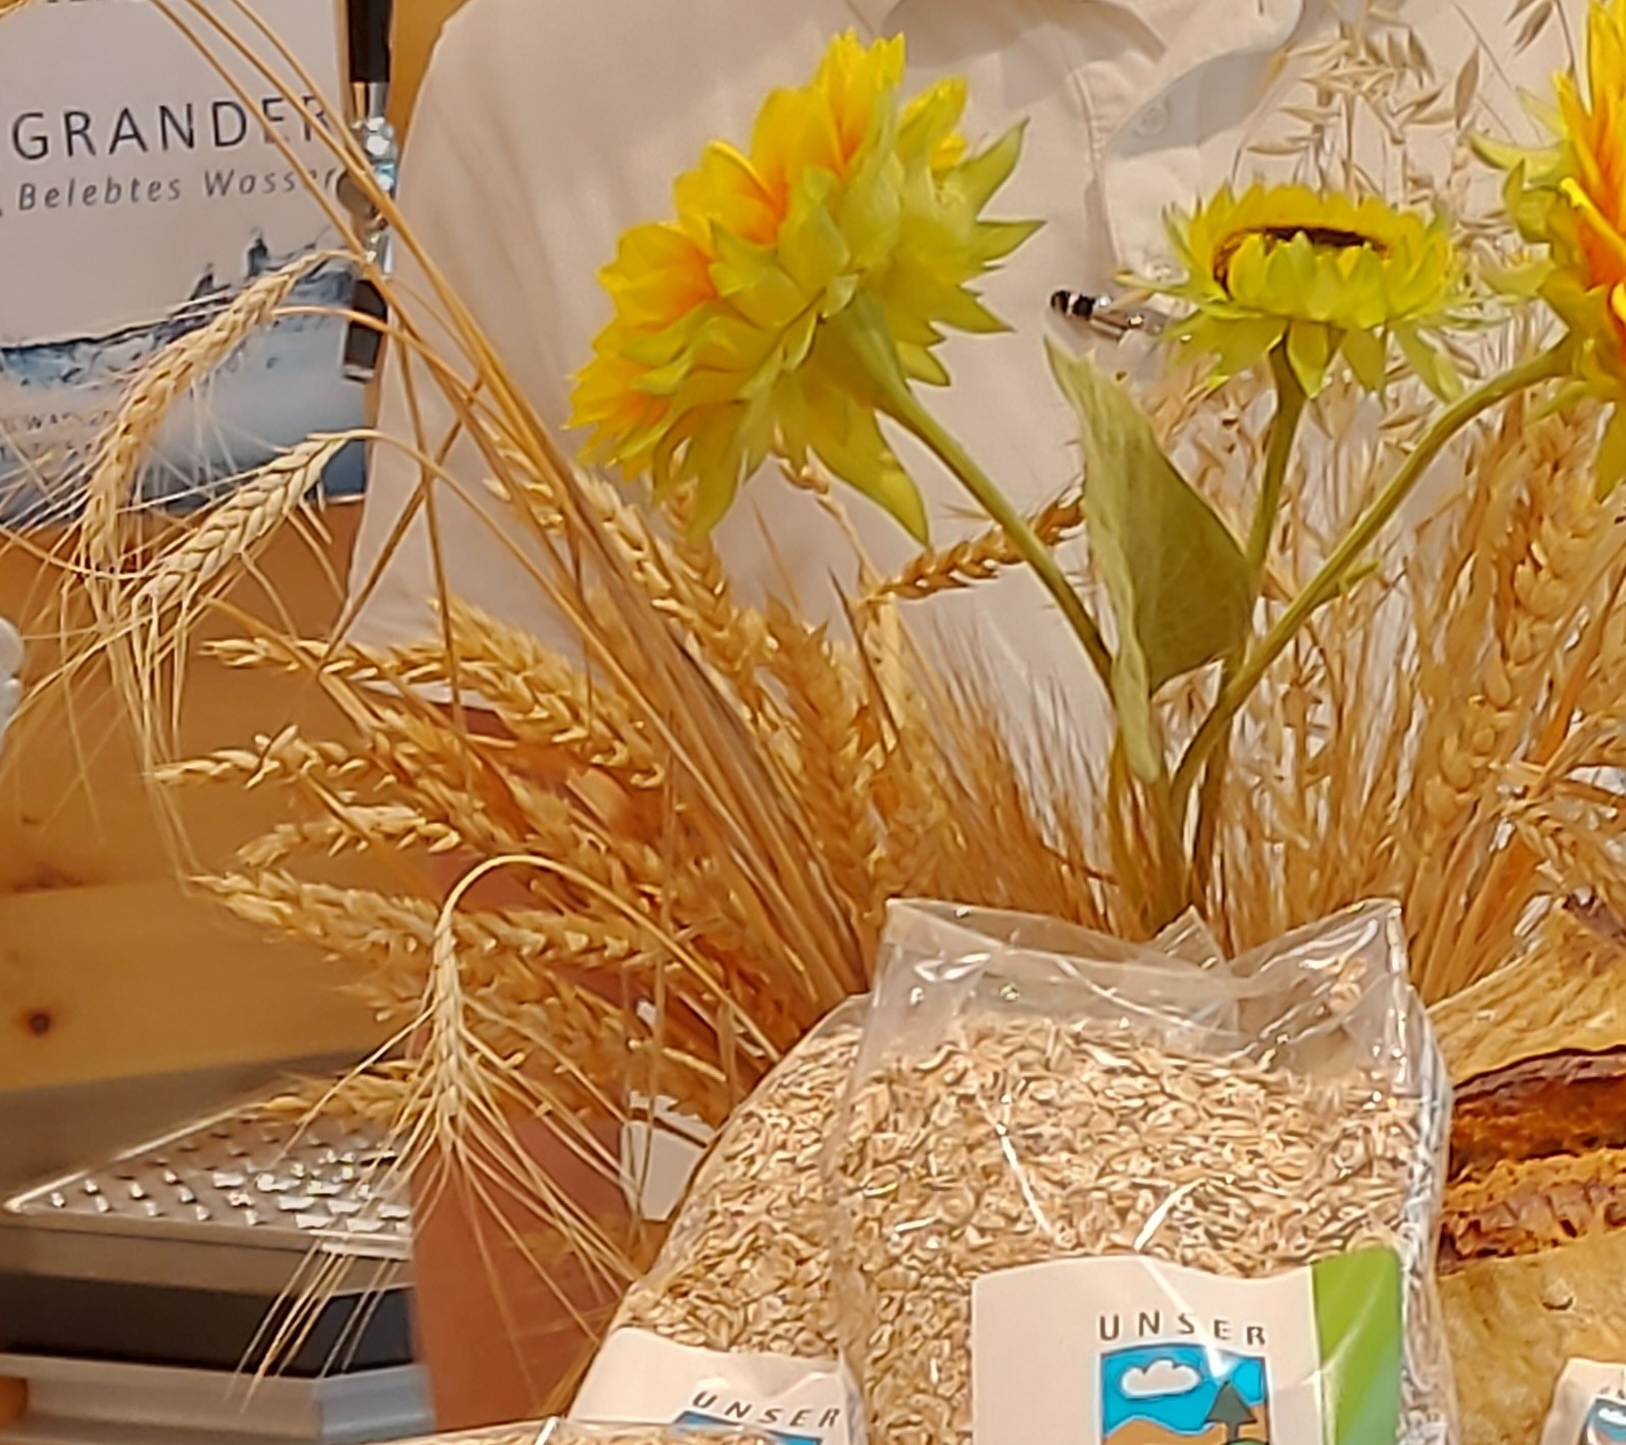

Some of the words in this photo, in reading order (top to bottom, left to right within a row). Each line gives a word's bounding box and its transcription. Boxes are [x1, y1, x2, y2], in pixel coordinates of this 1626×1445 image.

[18, 176, 182, 211] Belebtes
[1098, 1311, 1269, 1345] UNSER
[691, 1390, 842, 1429] UNSER
